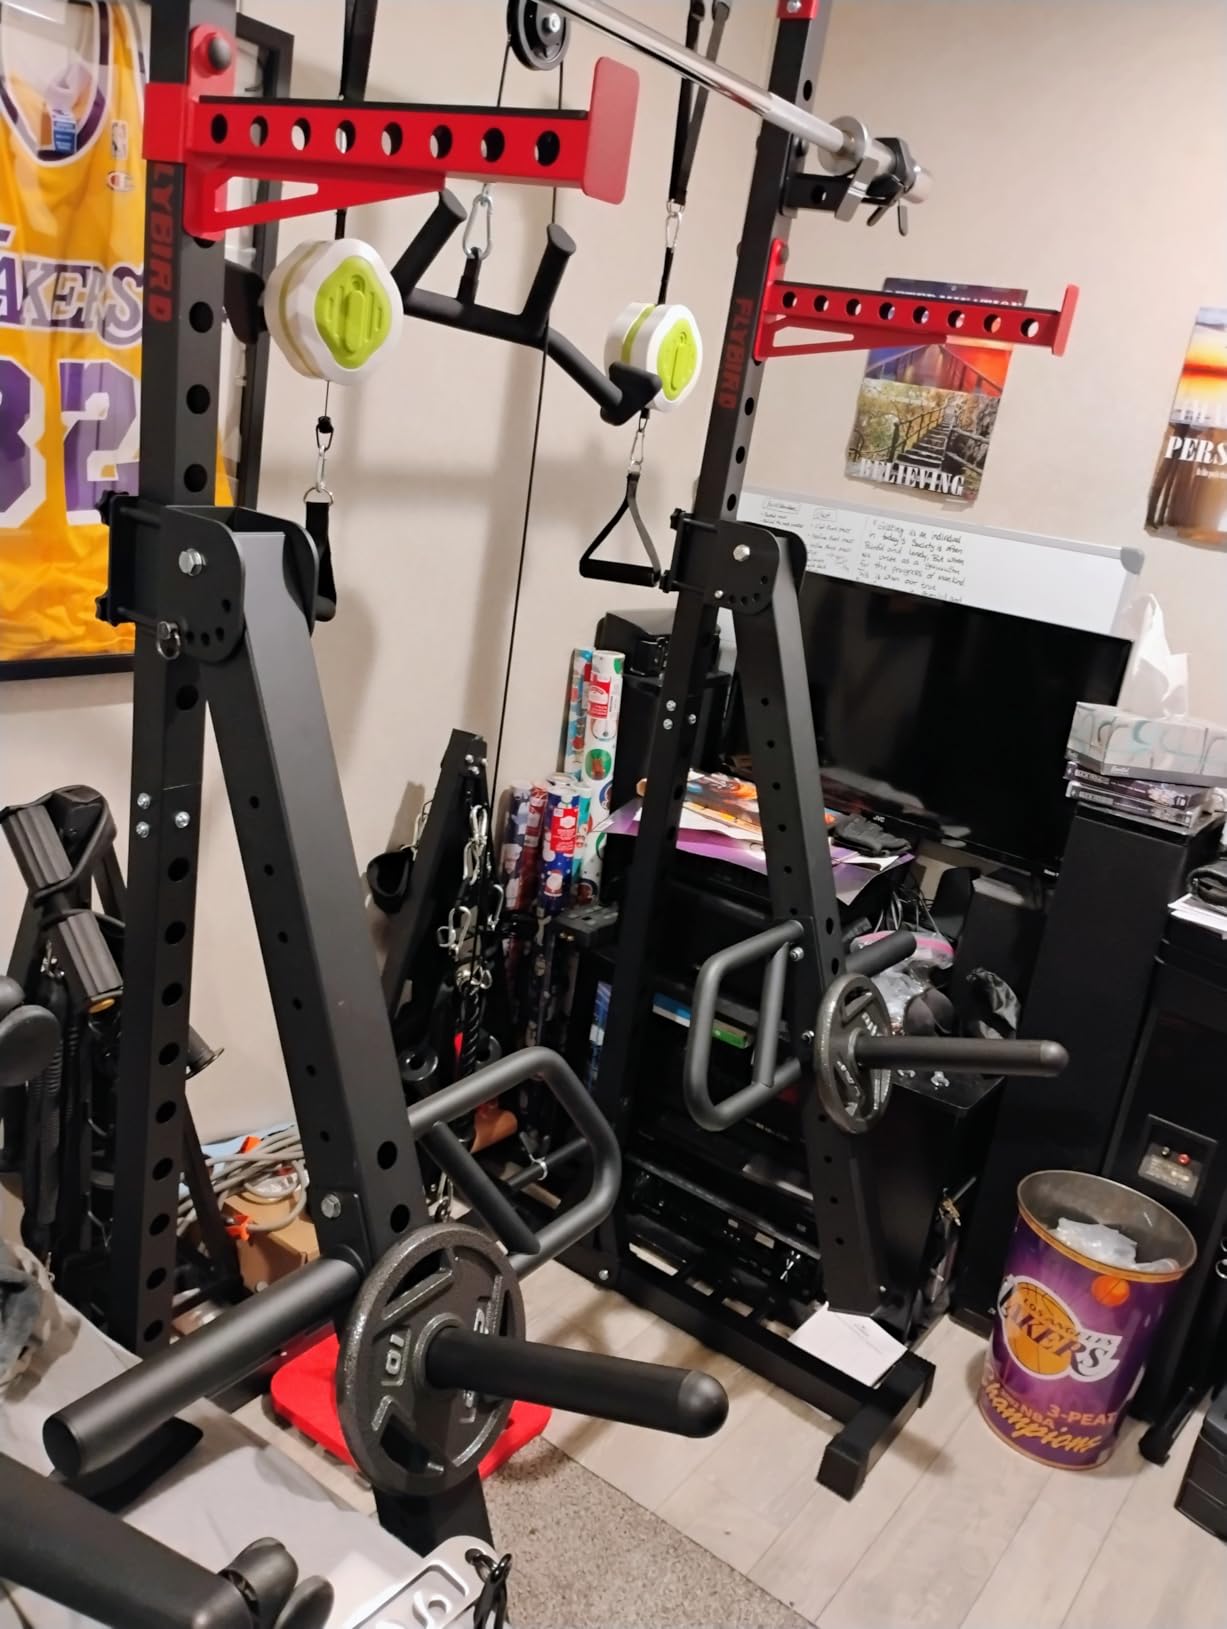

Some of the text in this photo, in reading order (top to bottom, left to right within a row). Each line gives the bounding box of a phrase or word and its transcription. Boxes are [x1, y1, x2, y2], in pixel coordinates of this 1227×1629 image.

[148, 163, 175, 322] LYBIRD
[718, 298, 754, 409] FLYBIRD
[859, 457, 965, 496] BELIEVING
[1047, 1404, 1118, 1426] 3-PEAT
